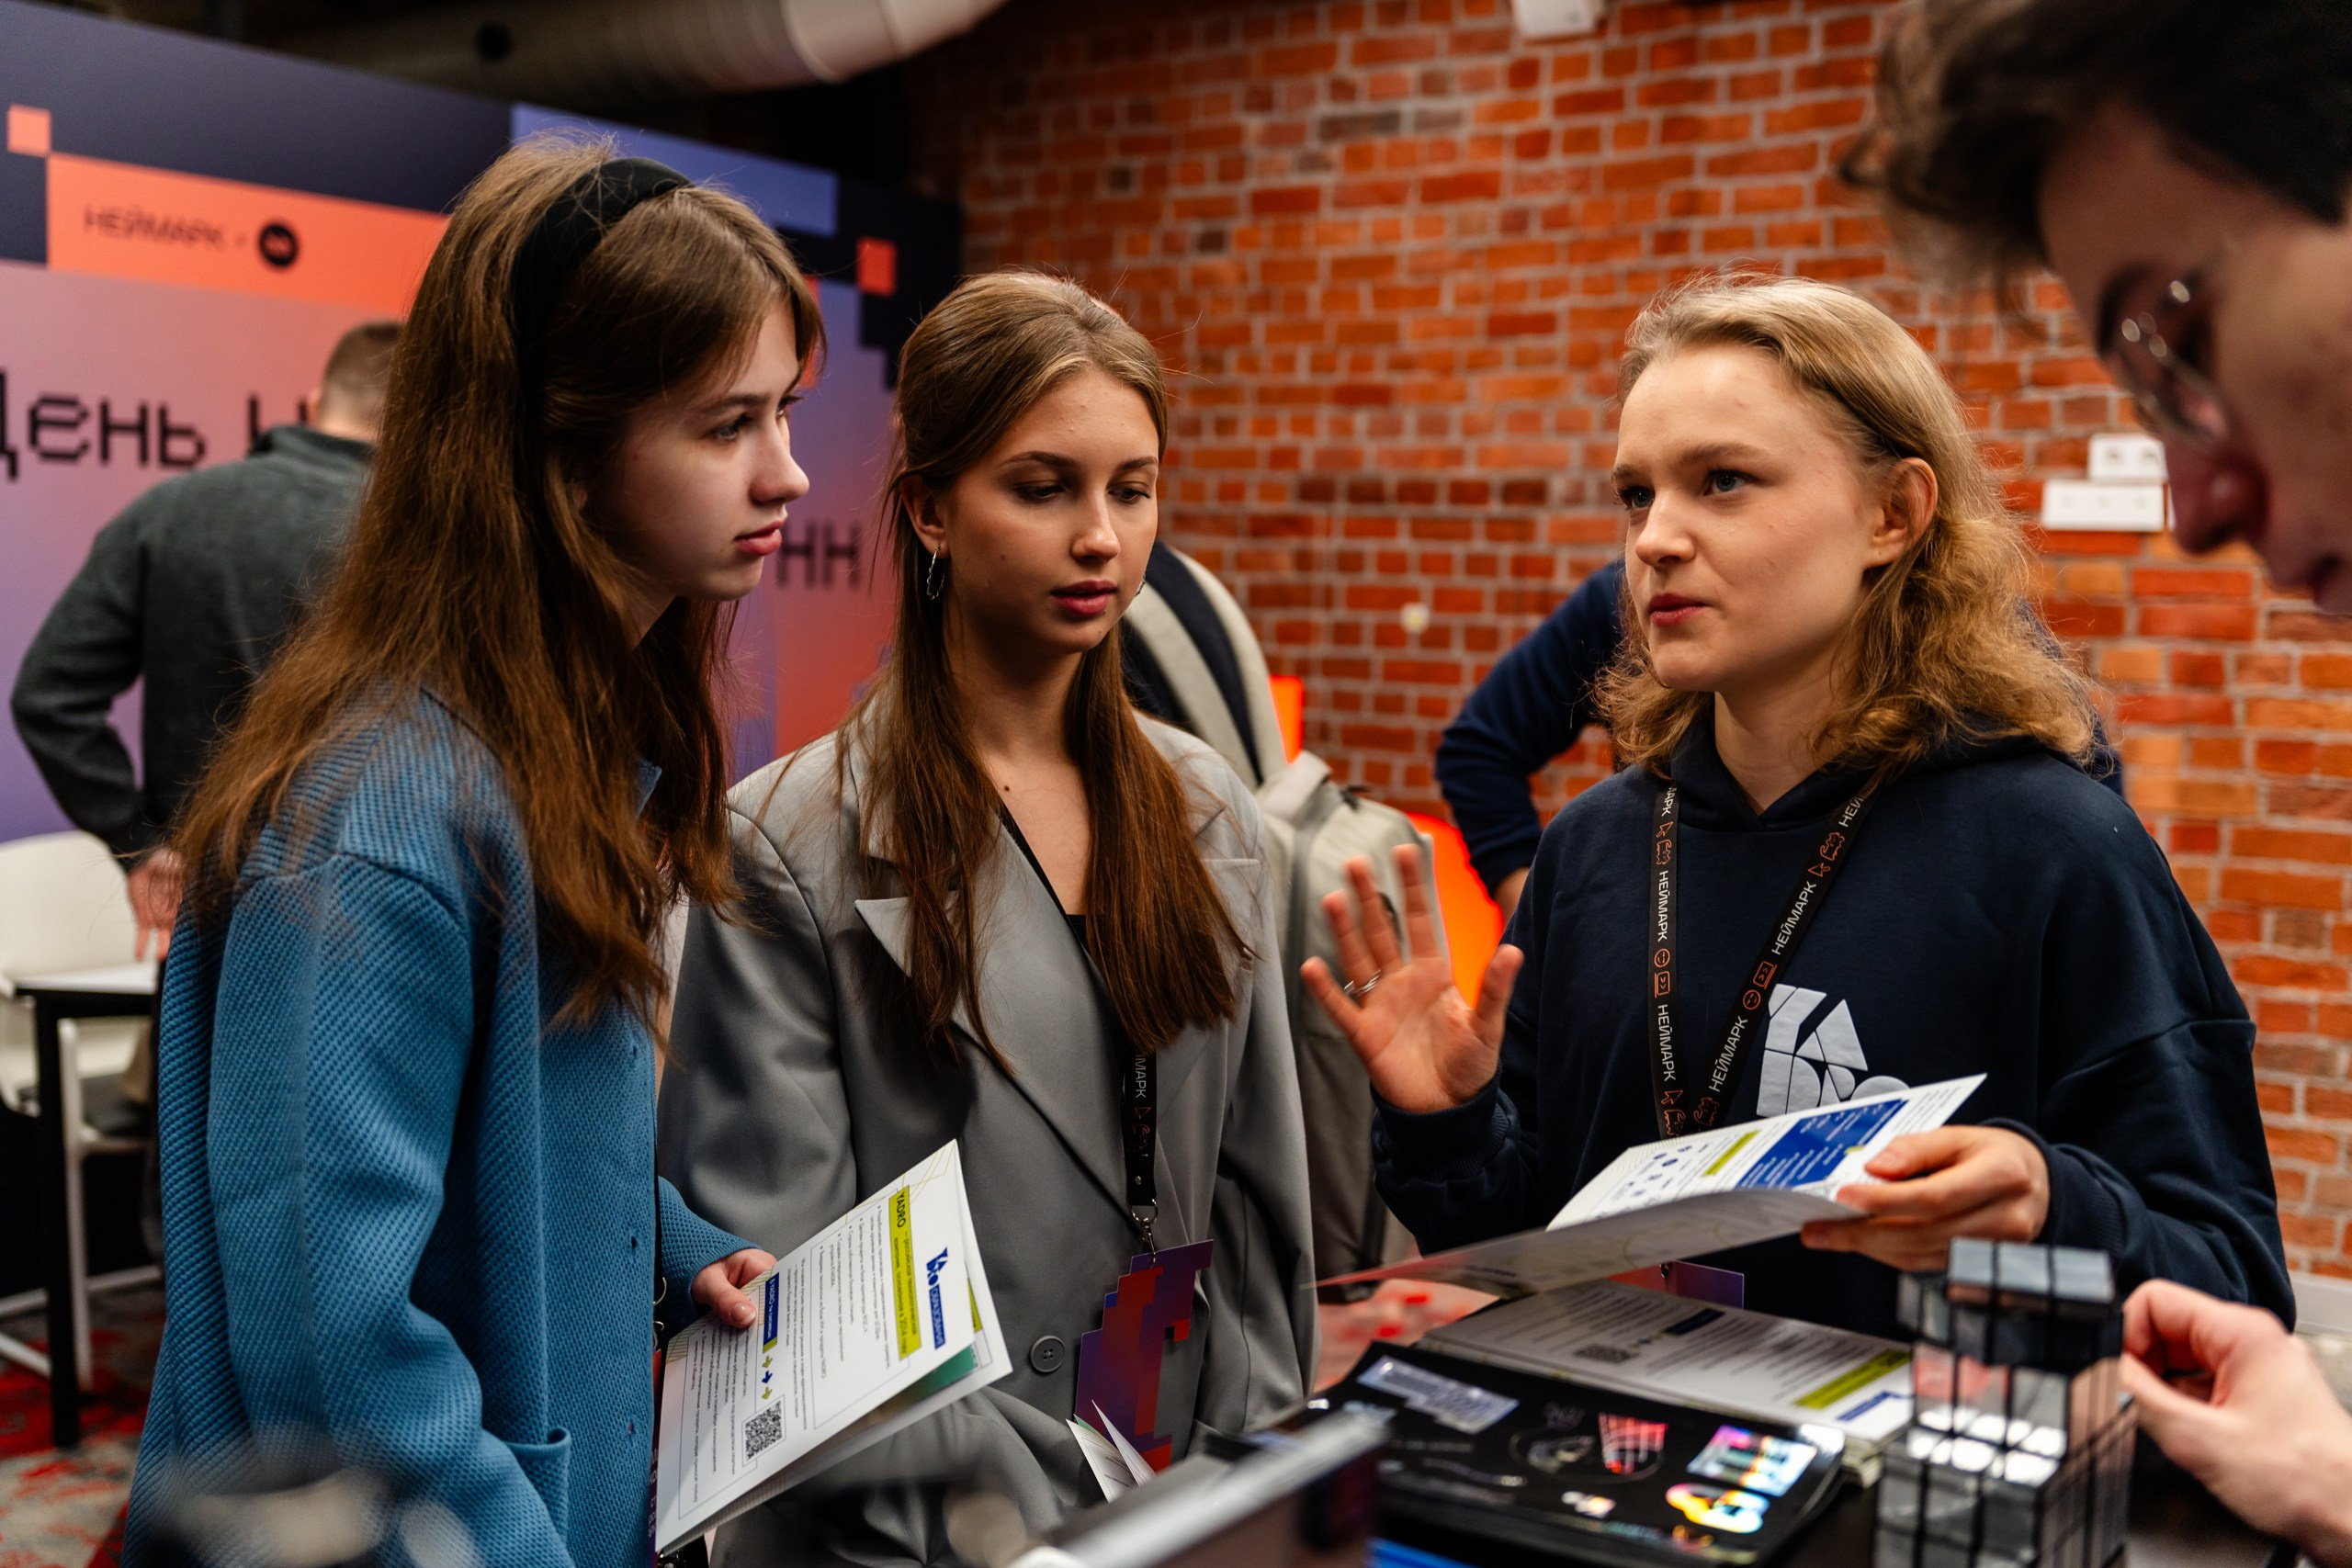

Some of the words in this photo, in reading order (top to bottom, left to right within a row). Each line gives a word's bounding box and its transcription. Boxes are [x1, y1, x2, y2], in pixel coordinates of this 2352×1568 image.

[1657, 870, 1670, 942] НЕЙМАРК
[1771, 880, 1817, 955] НЕЙМАРК
[1135, 1055, 1147, 1099] МАРК
[1657, 1003, 1677, 1082] НЕЙМАРК
[1708, 1015, 1748, 1093] НЕЙМАРК
[895, 1192, 906, 1228] YADRO
